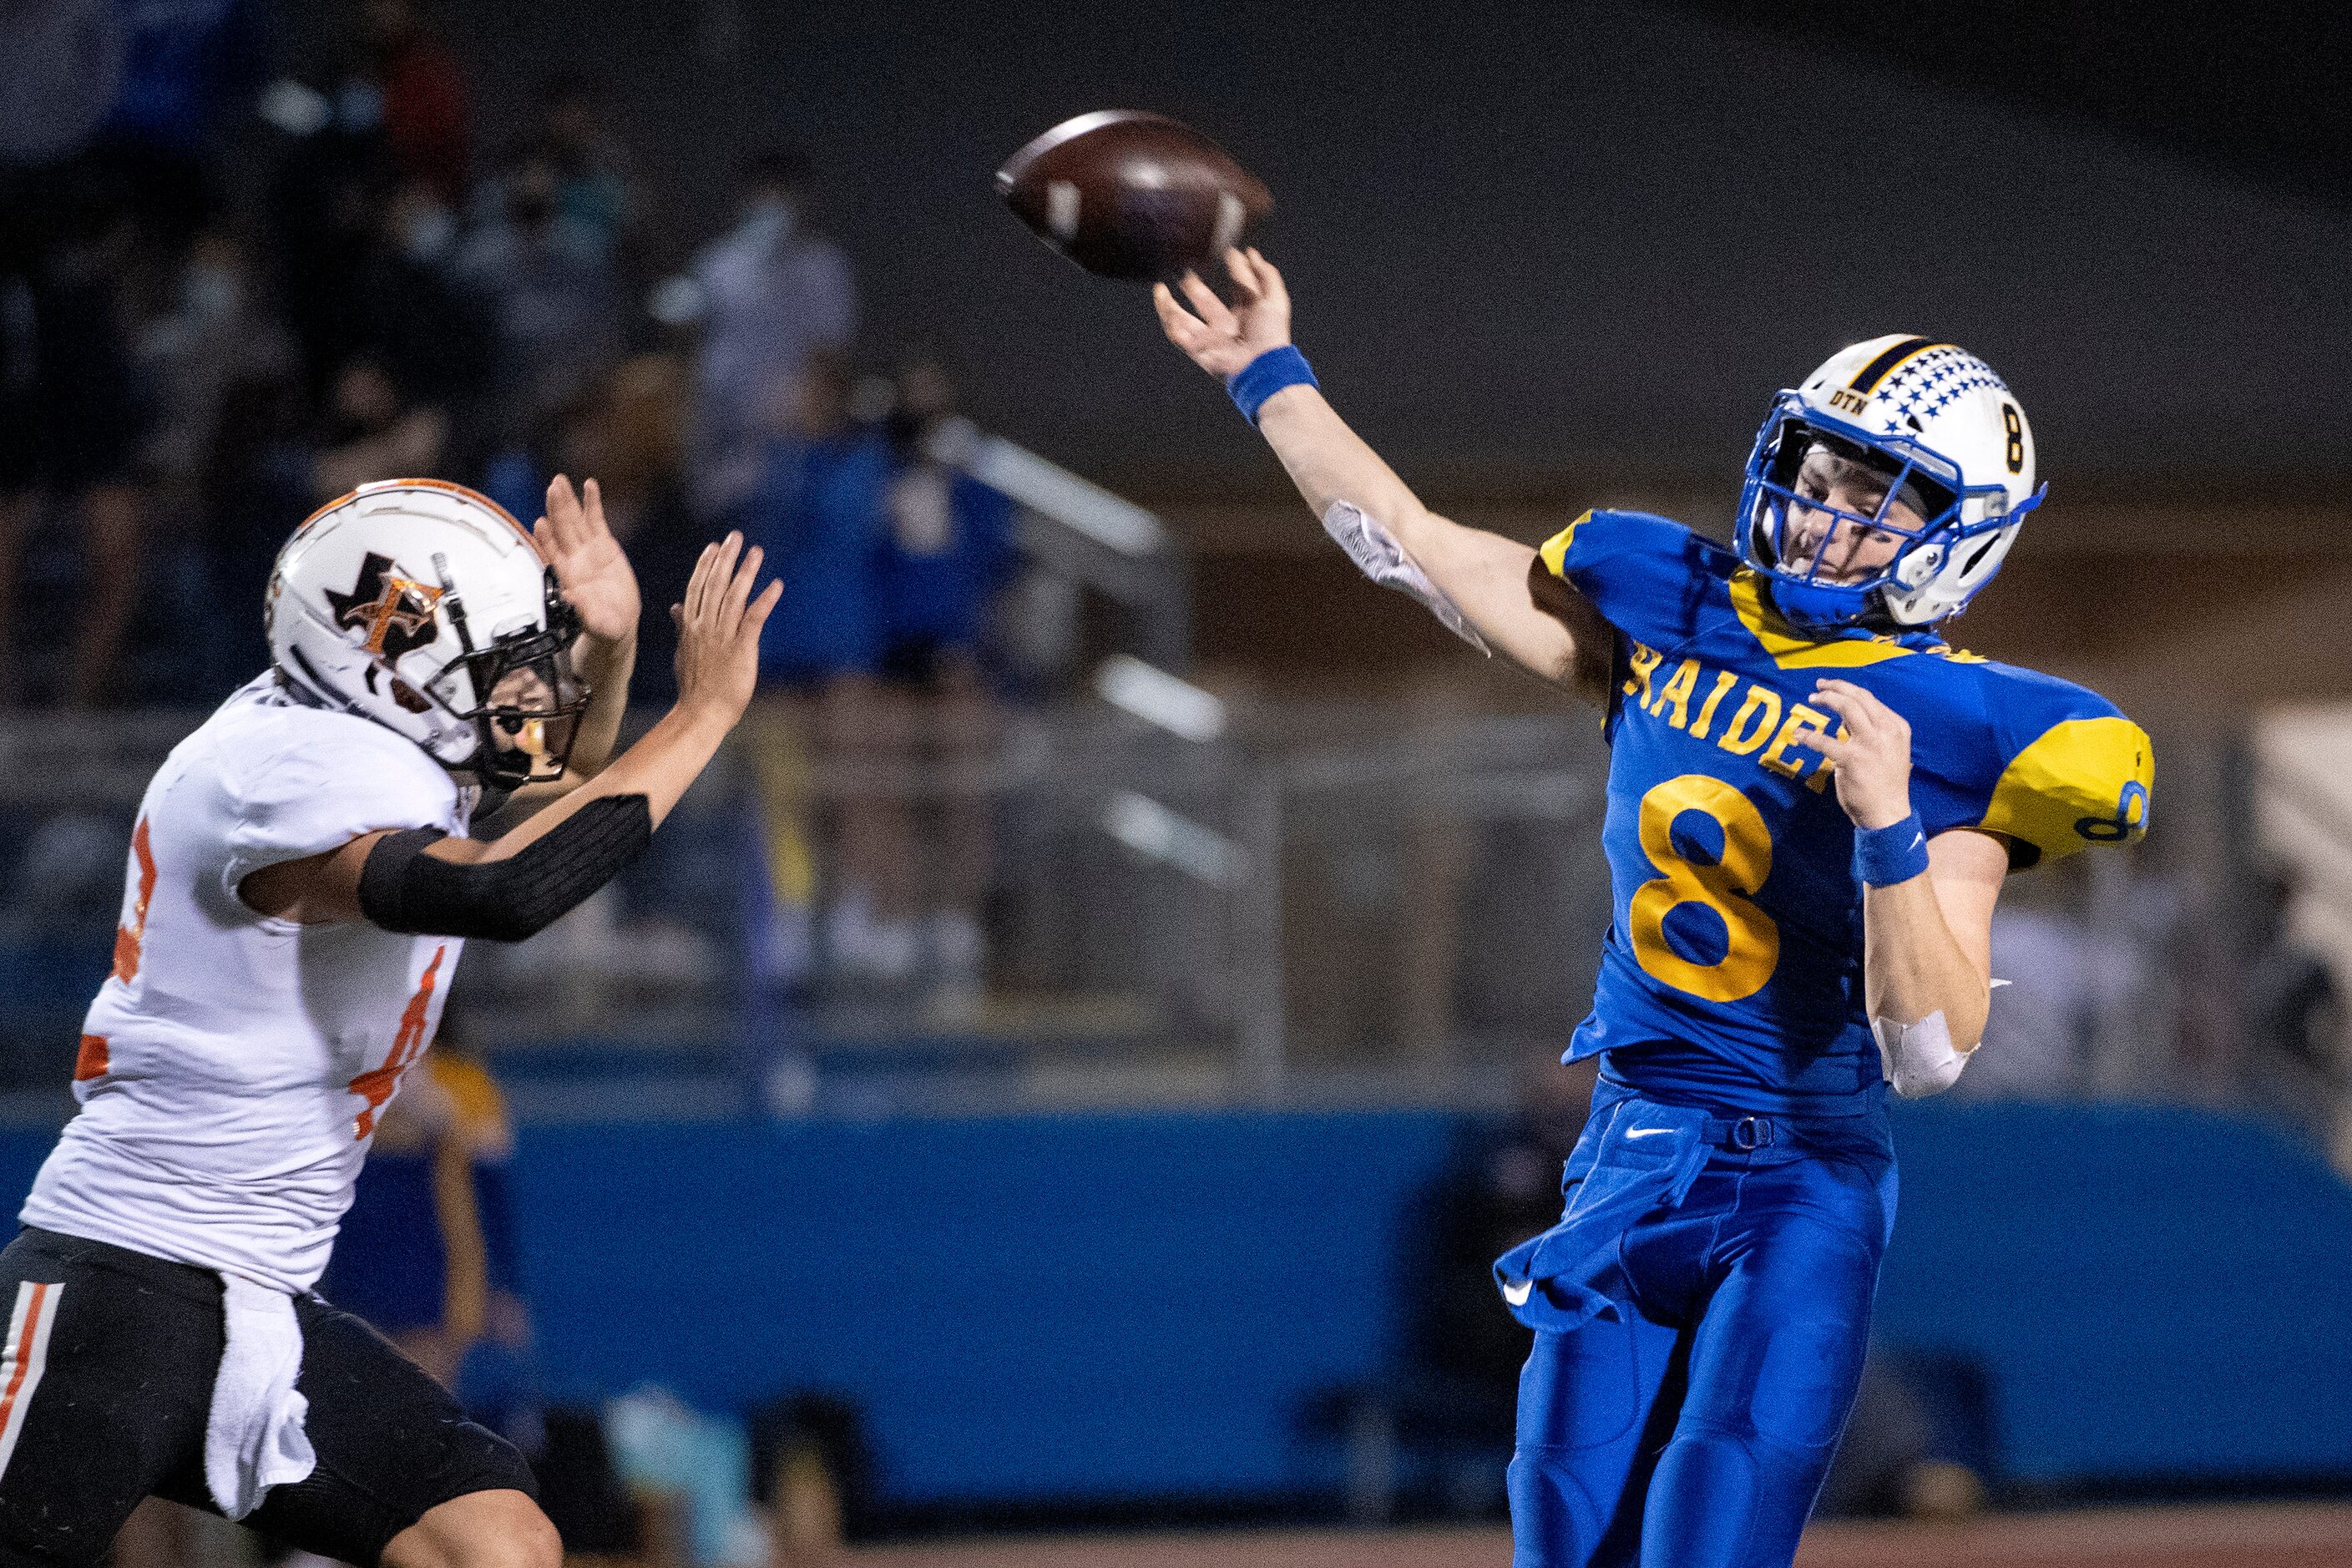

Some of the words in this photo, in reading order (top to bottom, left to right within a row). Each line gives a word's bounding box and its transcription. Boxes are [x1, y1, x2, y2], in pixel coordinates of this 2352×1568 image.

[1828, 388, 1869, 416] DTN
[2002, 402, 2024, 475] 8
[2073, 779, 2150, 842] 8
[1630, 775, 1779, 1003] 8
